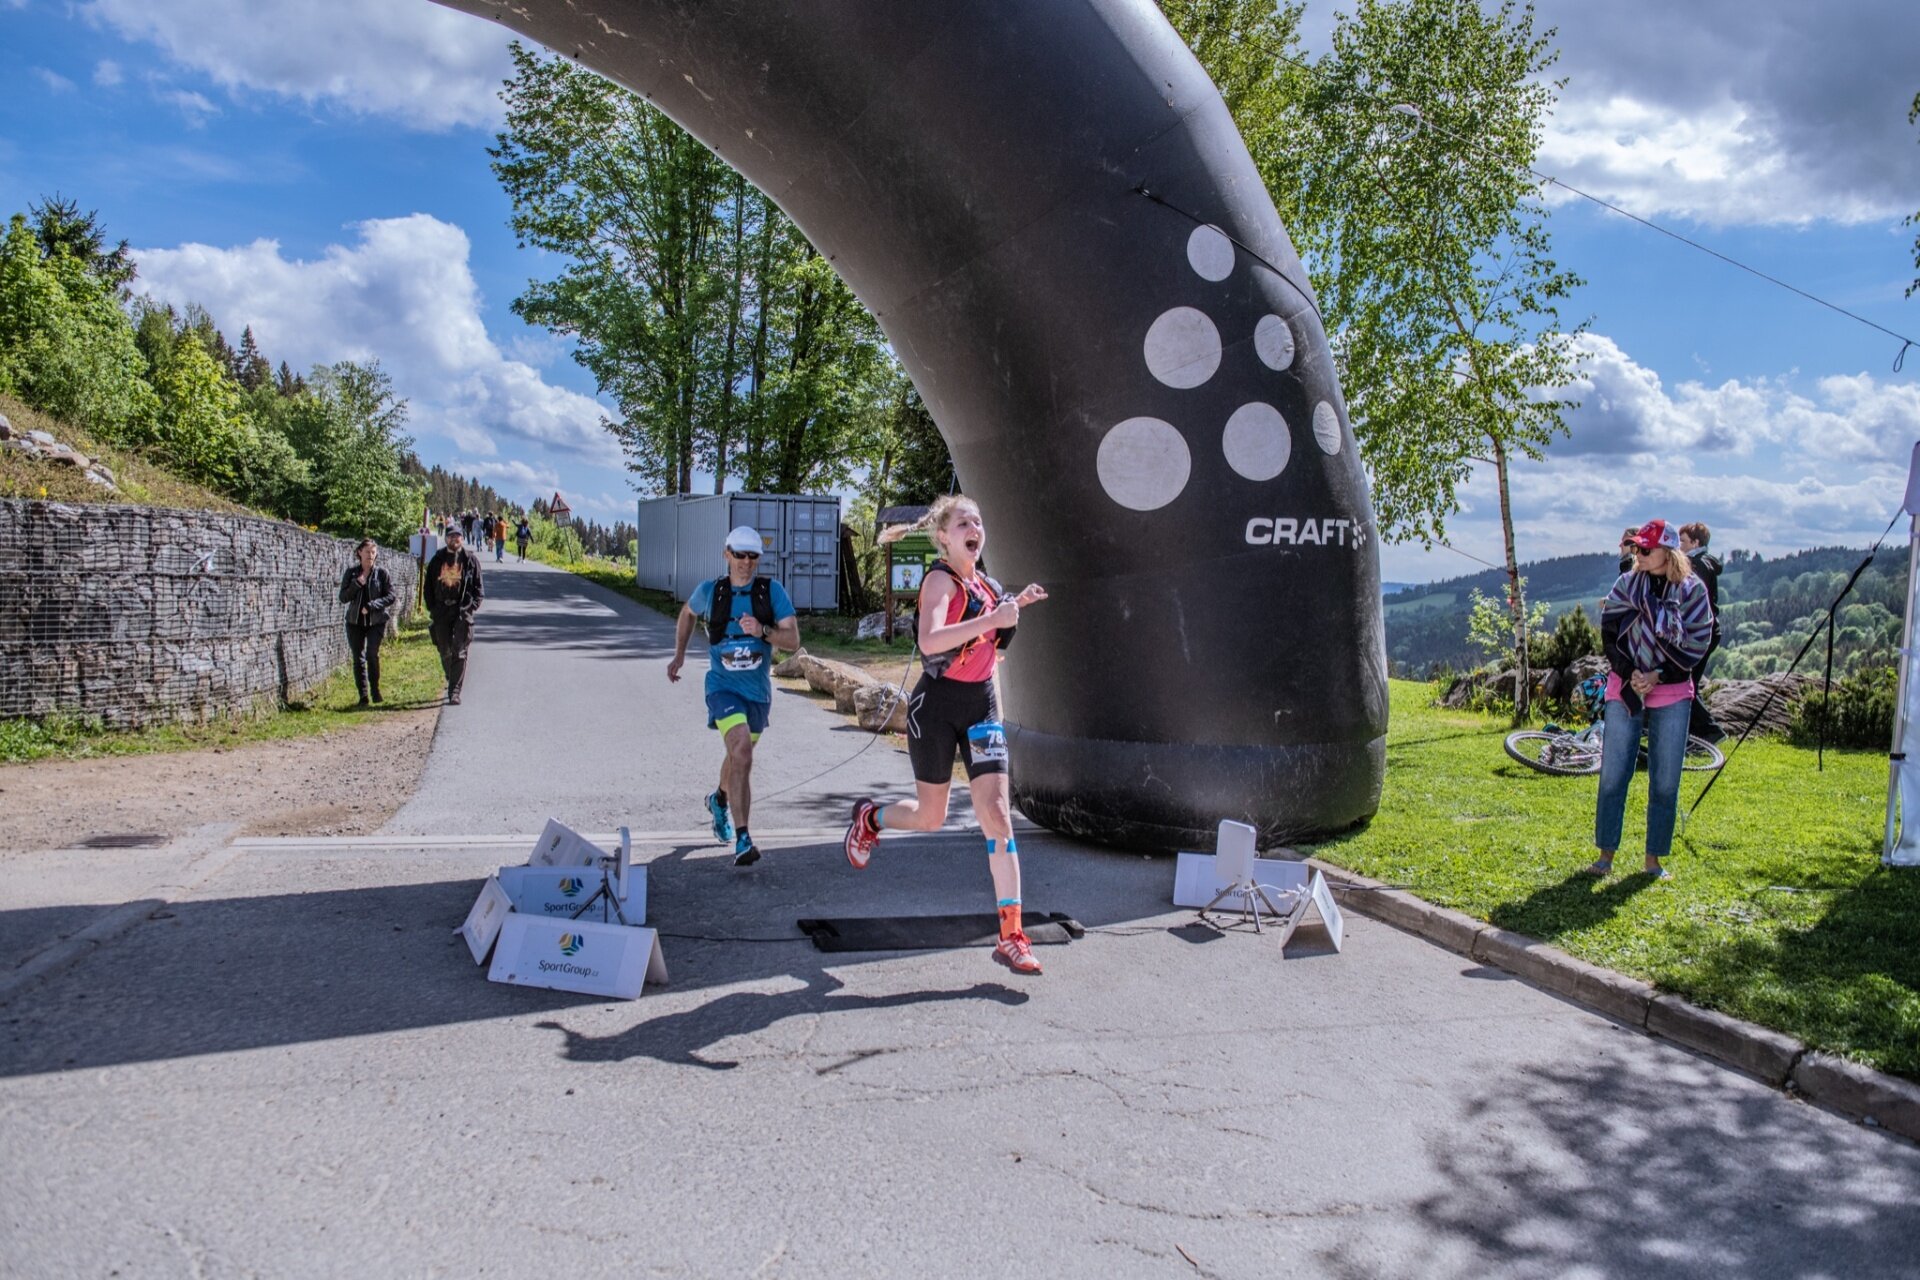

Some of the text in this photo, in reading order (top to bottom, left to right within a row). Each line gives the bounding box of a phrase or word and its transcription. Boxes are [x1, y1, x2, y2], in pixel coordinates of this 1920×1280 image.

[1245, 517, 1350, 546] CRAFT
[733, 646, 751, 658] 24
[986, 730, 1004, 744] 78
[538, 959, 592, 978] SportGroup
